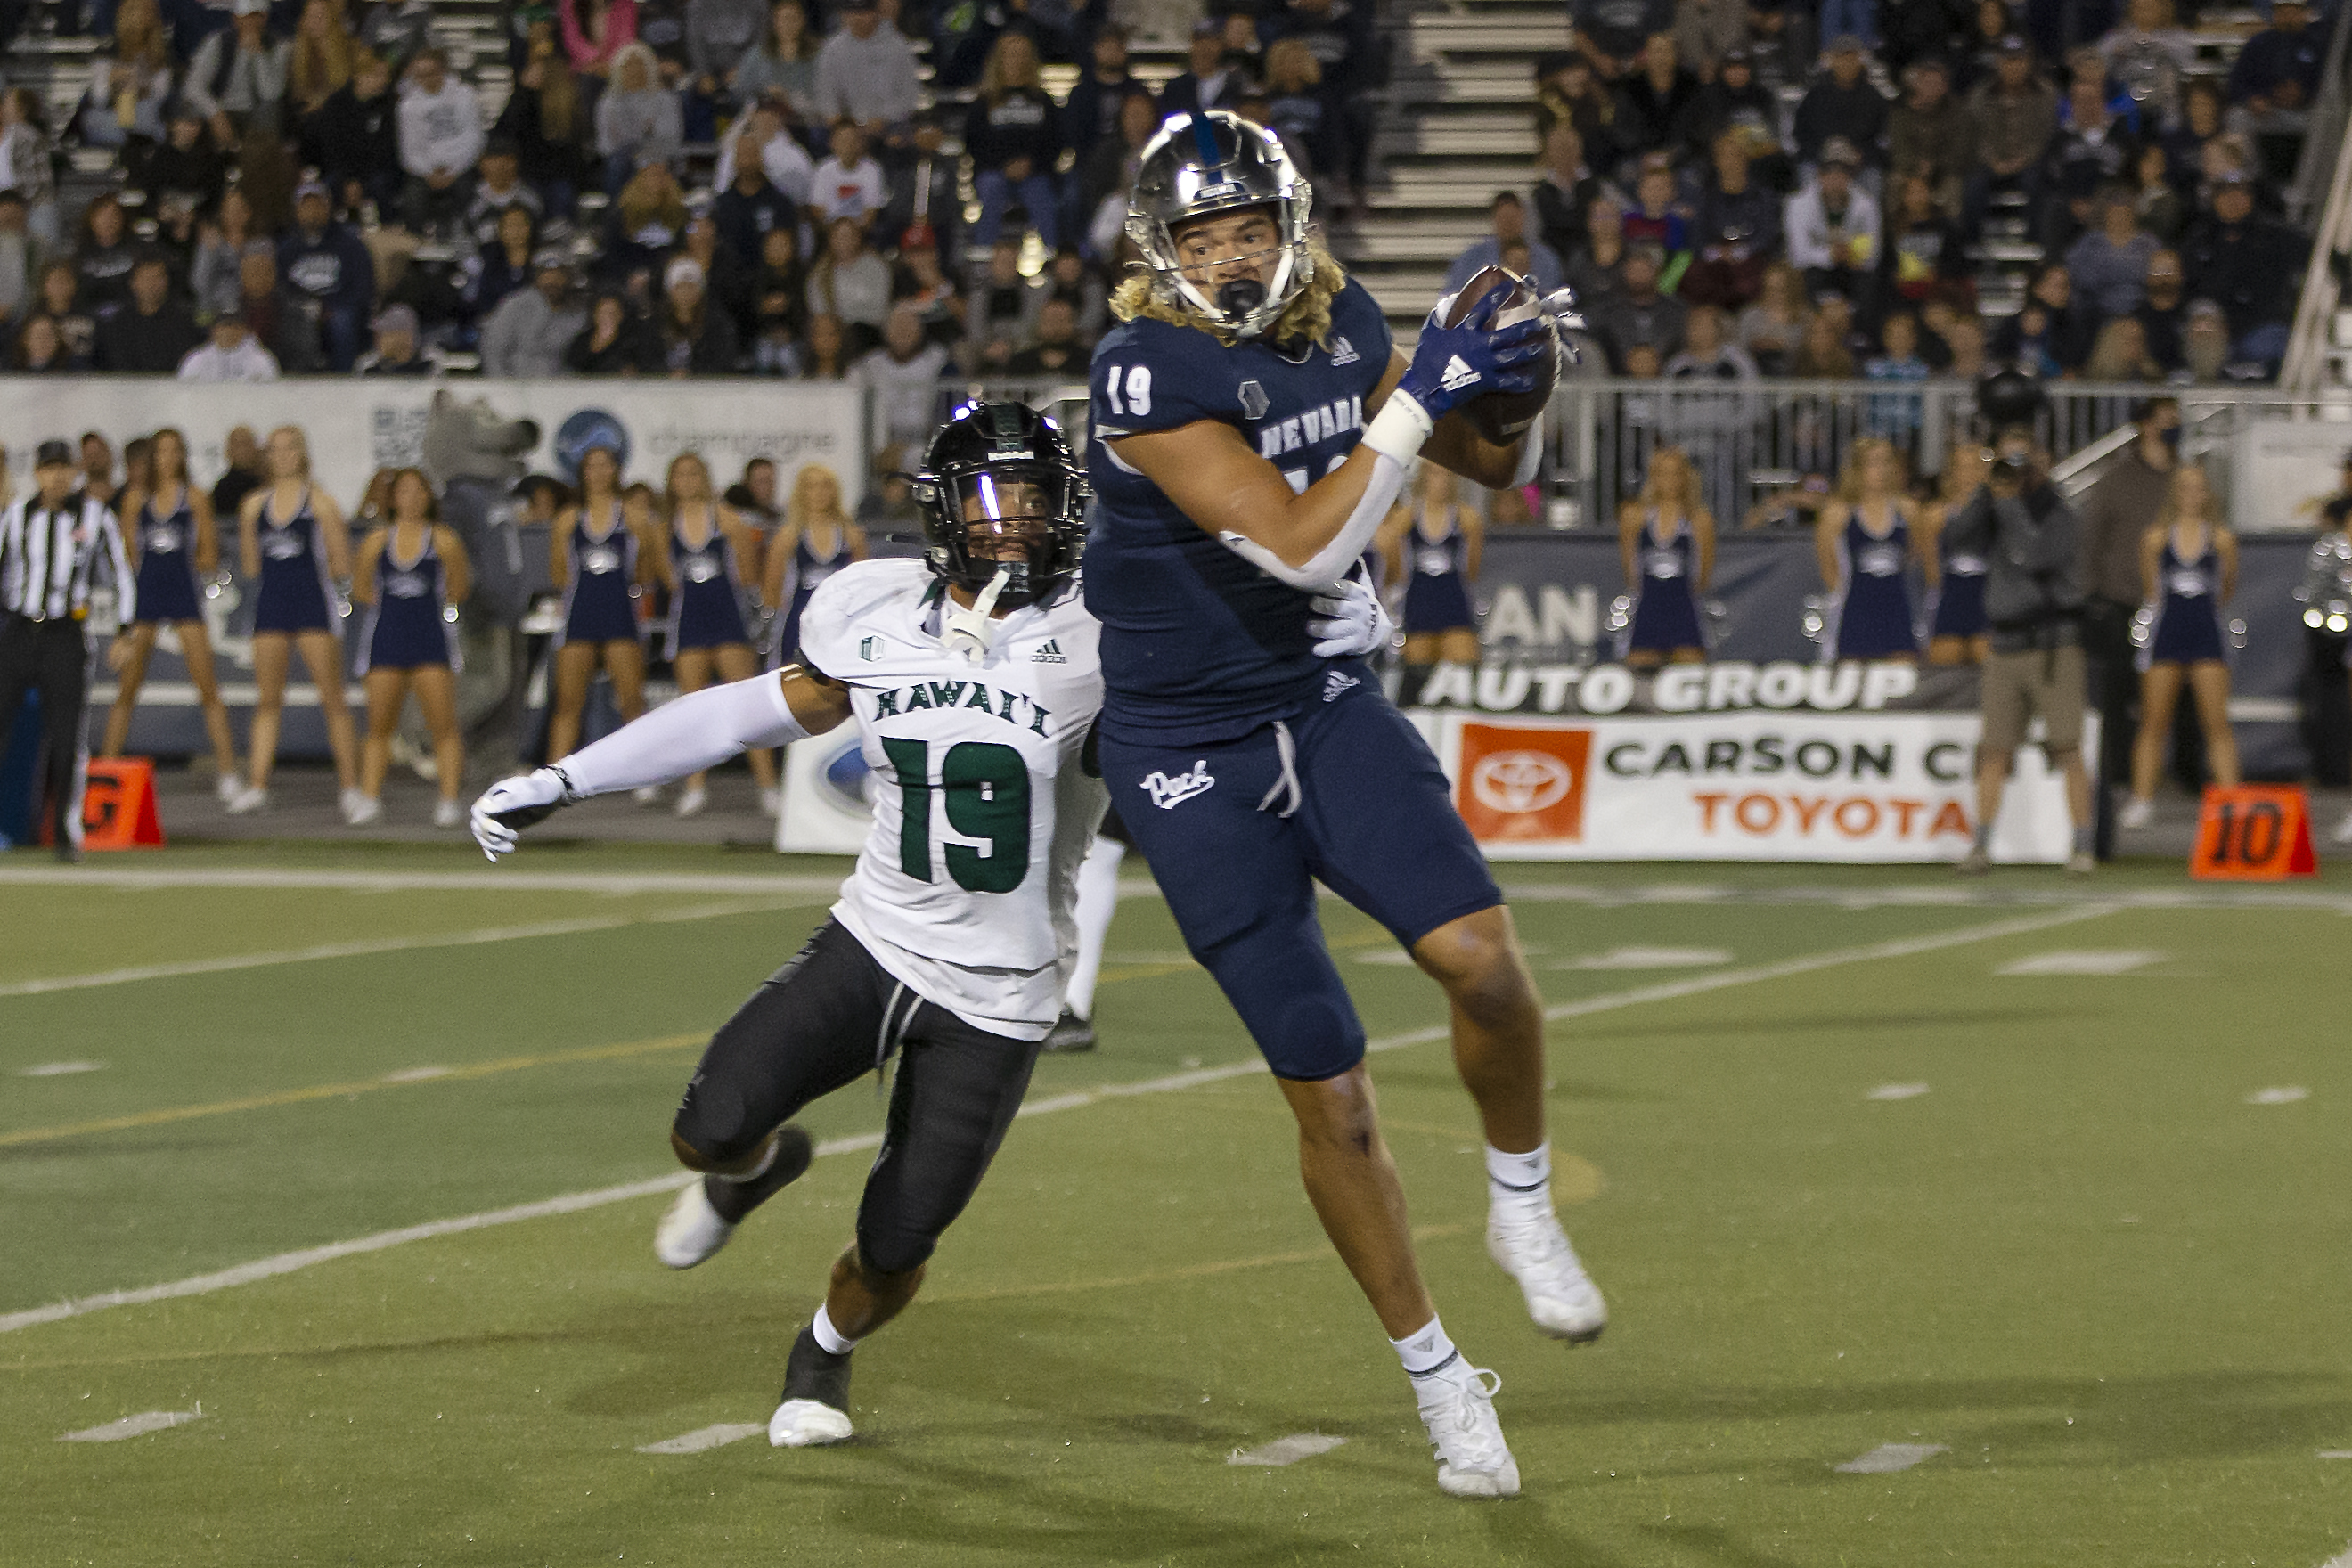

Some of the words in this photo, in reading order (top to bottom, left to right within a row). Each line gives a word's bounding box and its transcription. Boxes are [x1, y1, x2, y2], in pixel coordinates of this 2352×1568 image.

[1107, 365, 1152, 416] 19
[1480, 584, 1598, 645] AN
[1418, 662, 1635, 713] AUTO
[1652, 659, 1917, 711] GROUP
[1139, 759, 1215, 810] Pack
[1605, 738, 1895, 780] CARSON
[878, 735, 1033, 894] 19
[1693, 793, 1972, 840] TOYOTA
[2209, 801, 2283, 867] 10
